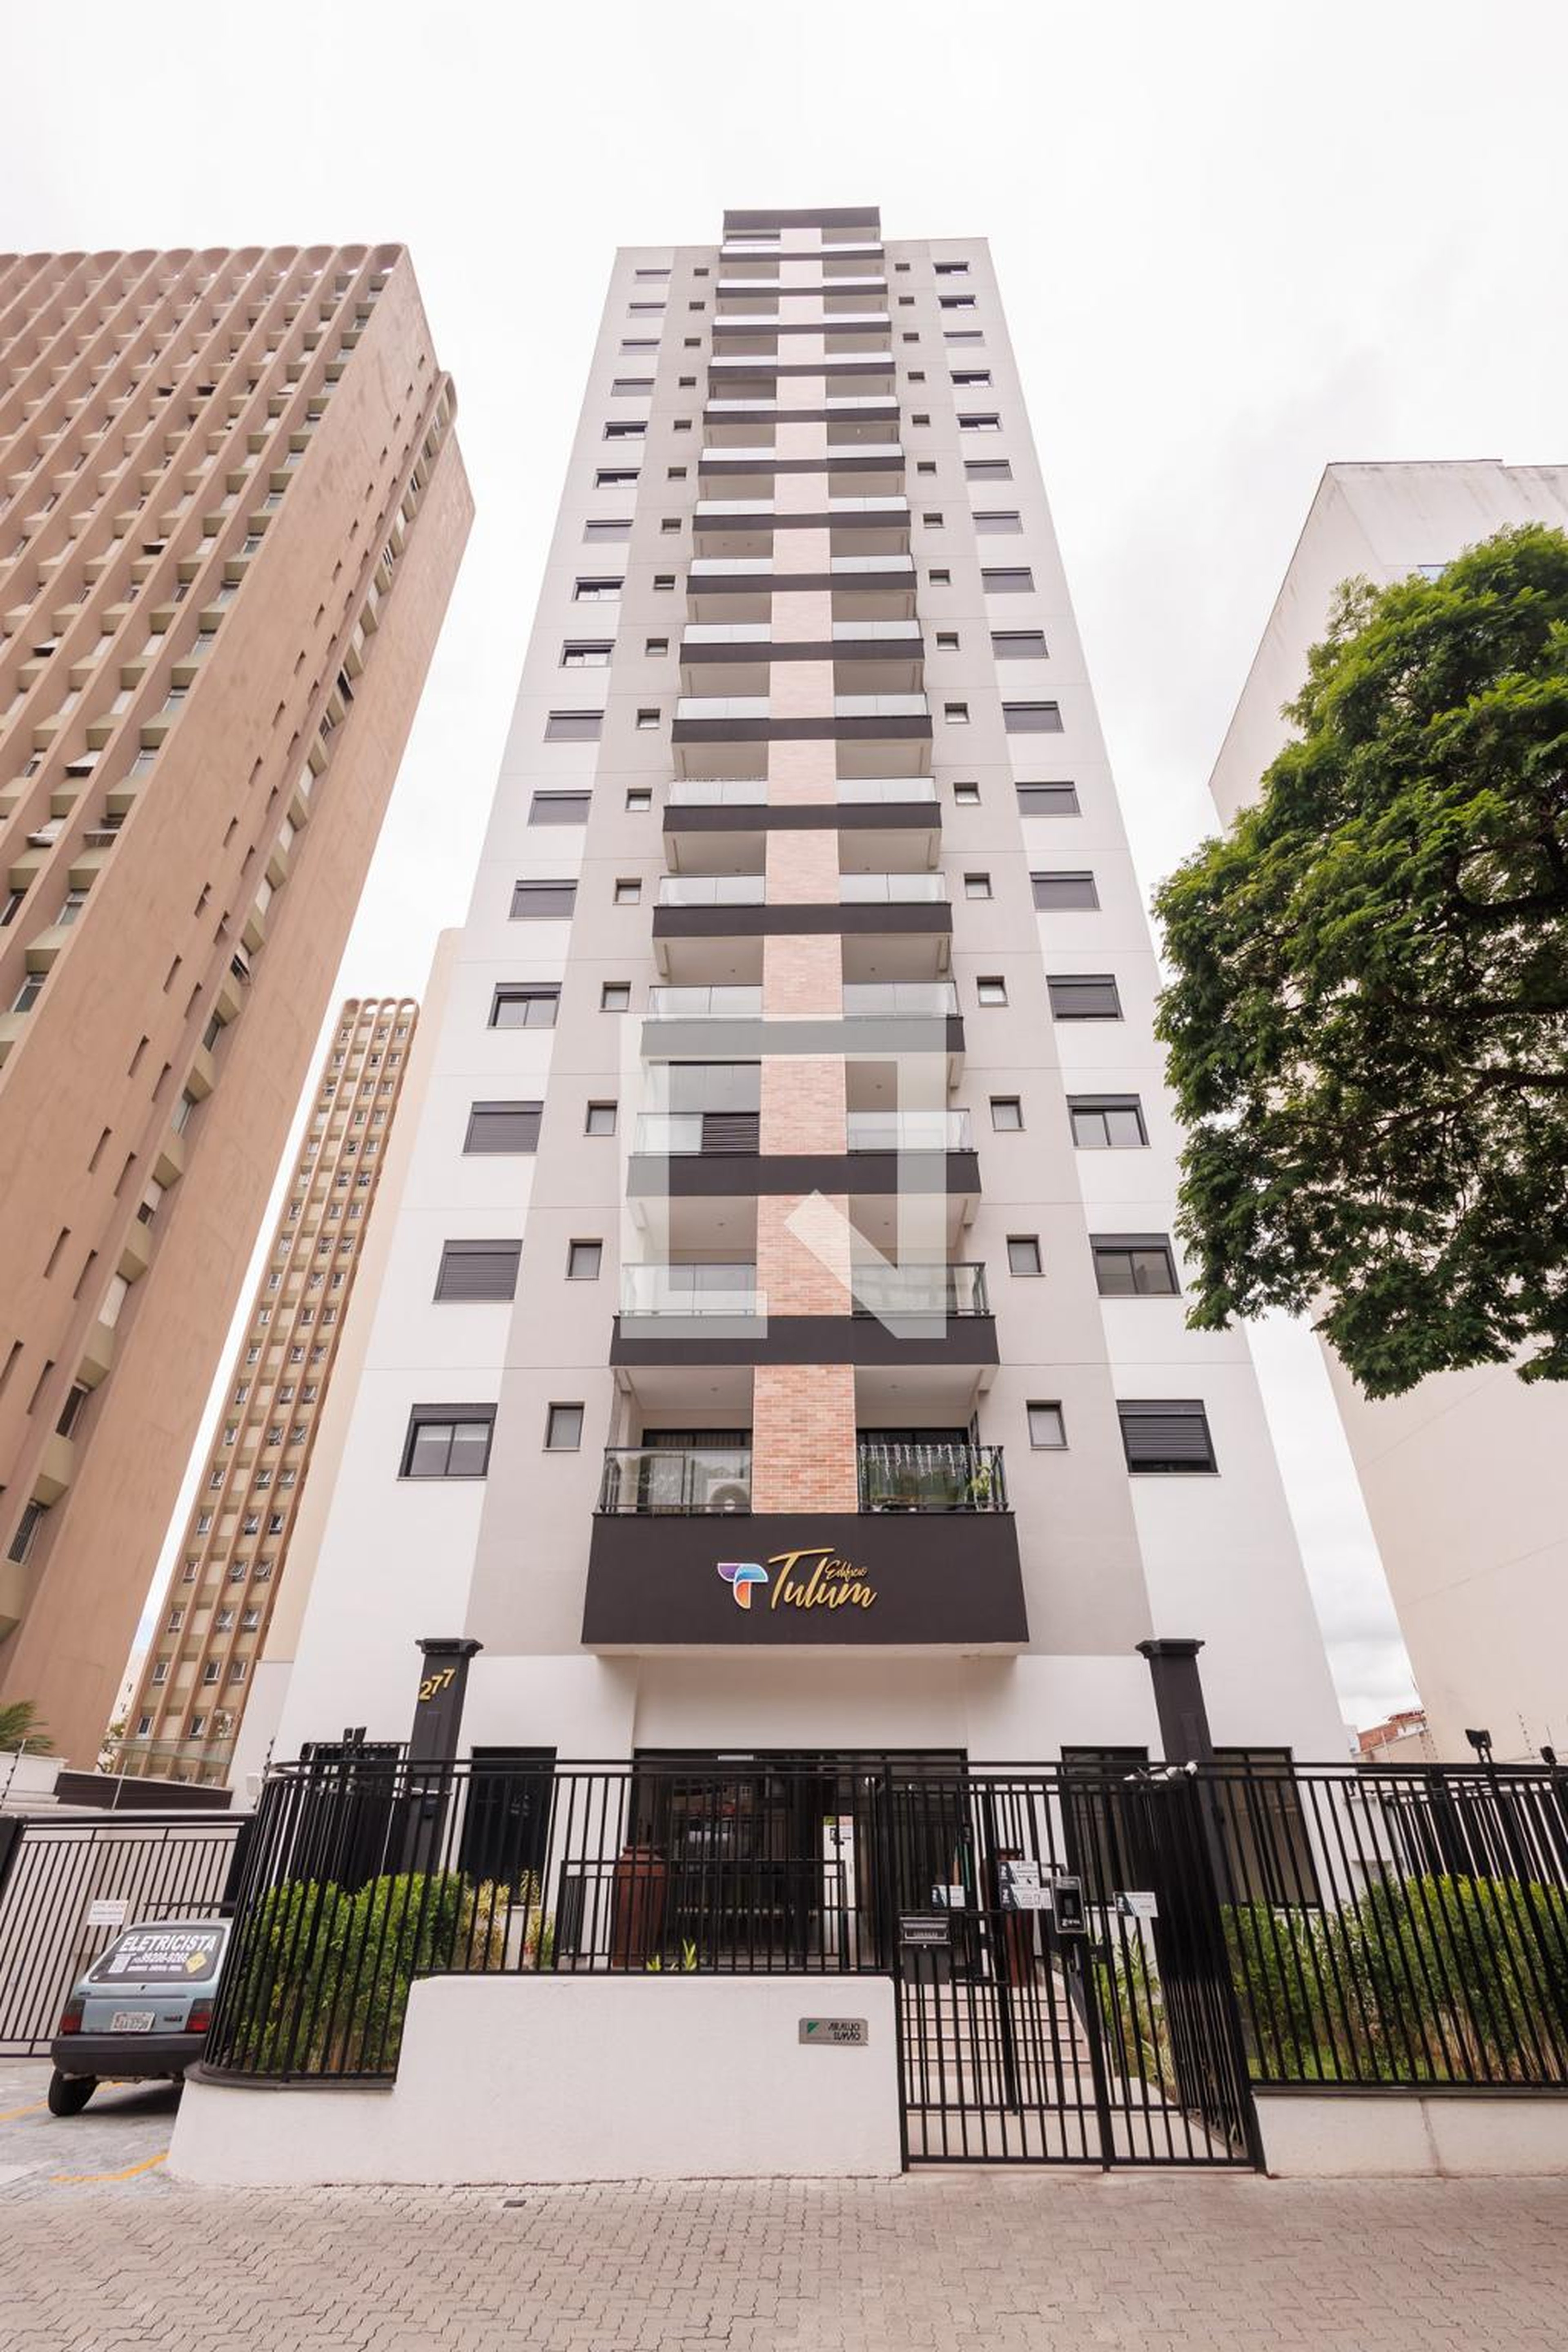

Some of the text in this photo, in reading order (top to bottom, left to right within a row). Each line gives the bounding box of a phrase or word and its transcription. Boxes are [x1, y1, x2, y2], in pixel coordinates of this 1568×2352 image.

[768, 1548, 878, 1609] Tulum
[419, 1668, 455, 1700] 277
[119, 1935, 217, 1951] ELETRICISTA
